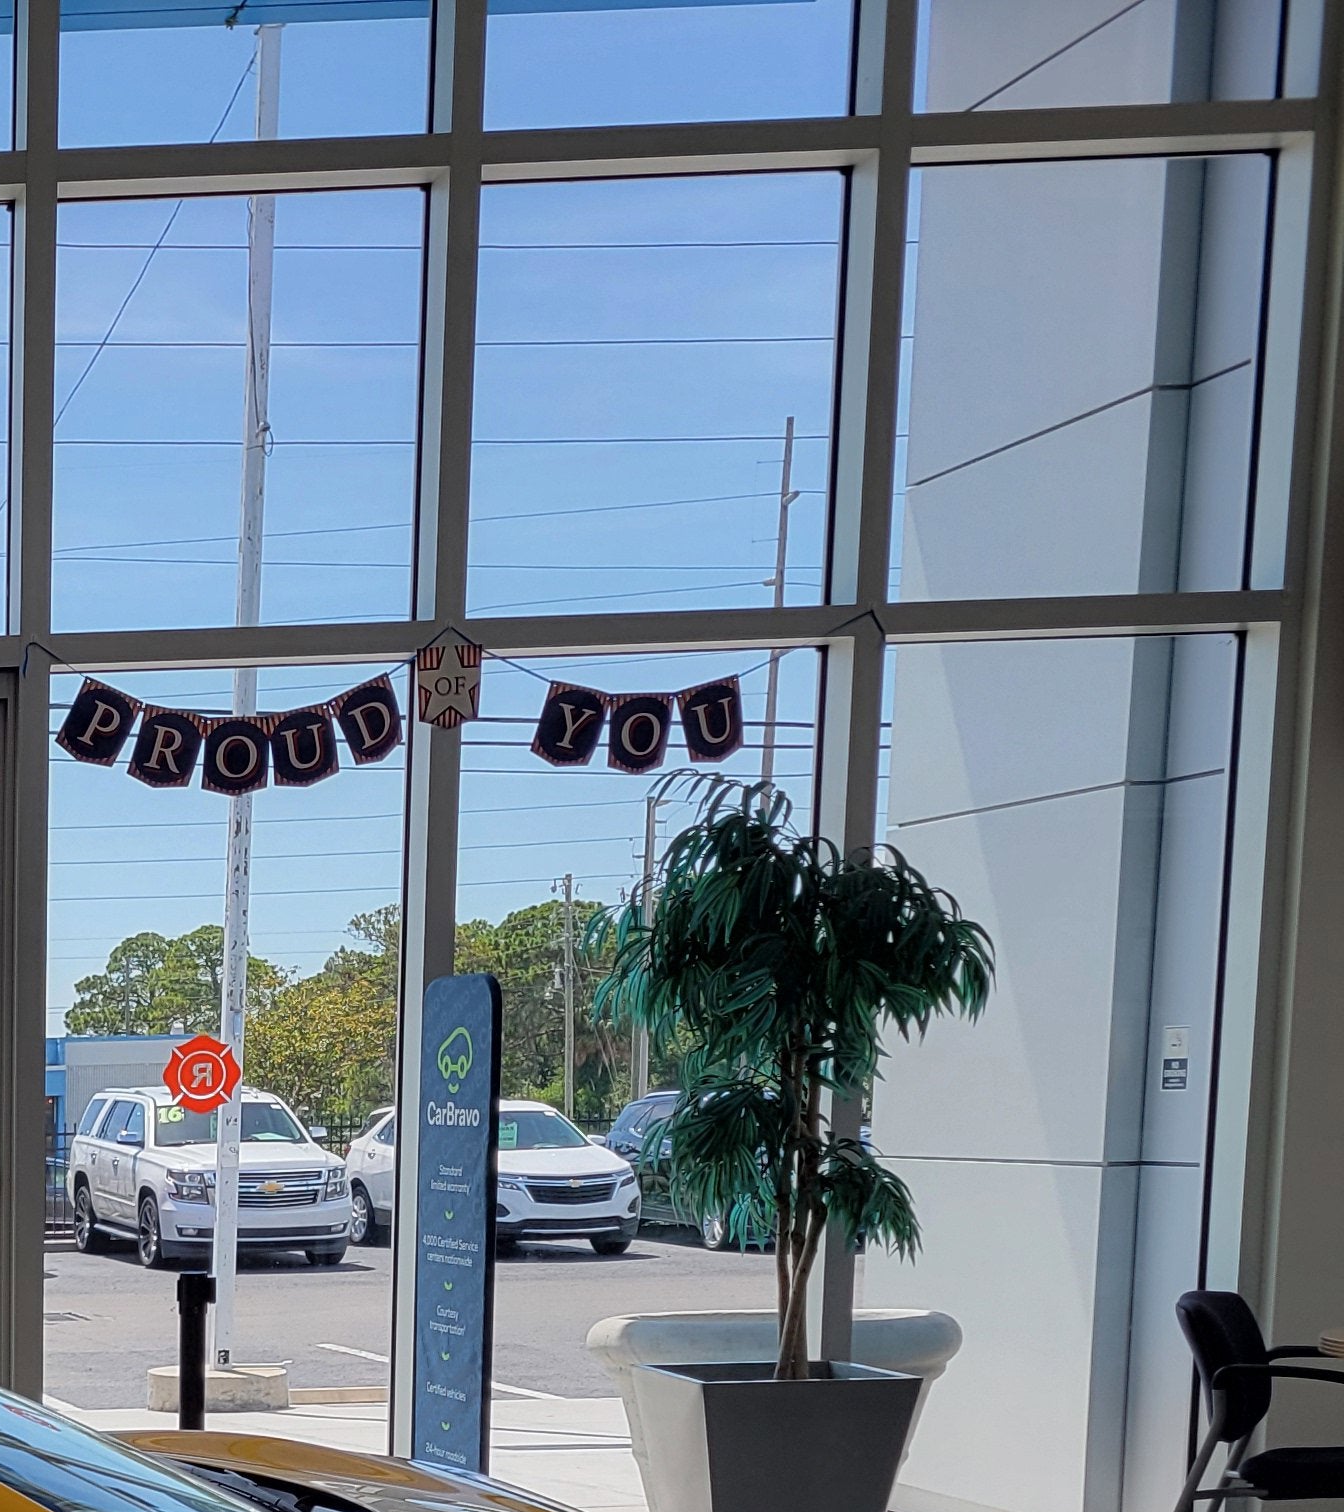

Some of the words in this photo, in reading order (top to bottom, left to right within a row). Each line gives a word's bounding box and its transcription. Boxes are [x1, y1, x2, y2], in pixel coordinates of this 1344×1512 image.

[76, 699, 392, 778] PROUD
[433, 676, 467, 697] OF
[555, 696, 733, 756] YOU
[427, 1101, 480, 1127] CarBravo
[439, 1164, 463, 1177] Standard
[438, 1236, 459, 1250] Certified
[459, 1239, 479, 1252] Service
[427, 1252, 444, 1263] centers
[445, 1254, 473, 1267] nationwide
[436, 1304, 459, 1322] Courtesy
[426, 1381, 447, 1397] Certified
[447, 1387, 467, 1402] vehicles
[425, 1442, 445, 1458] 24-hour
[445, 1450, 467, 1465] roadside
